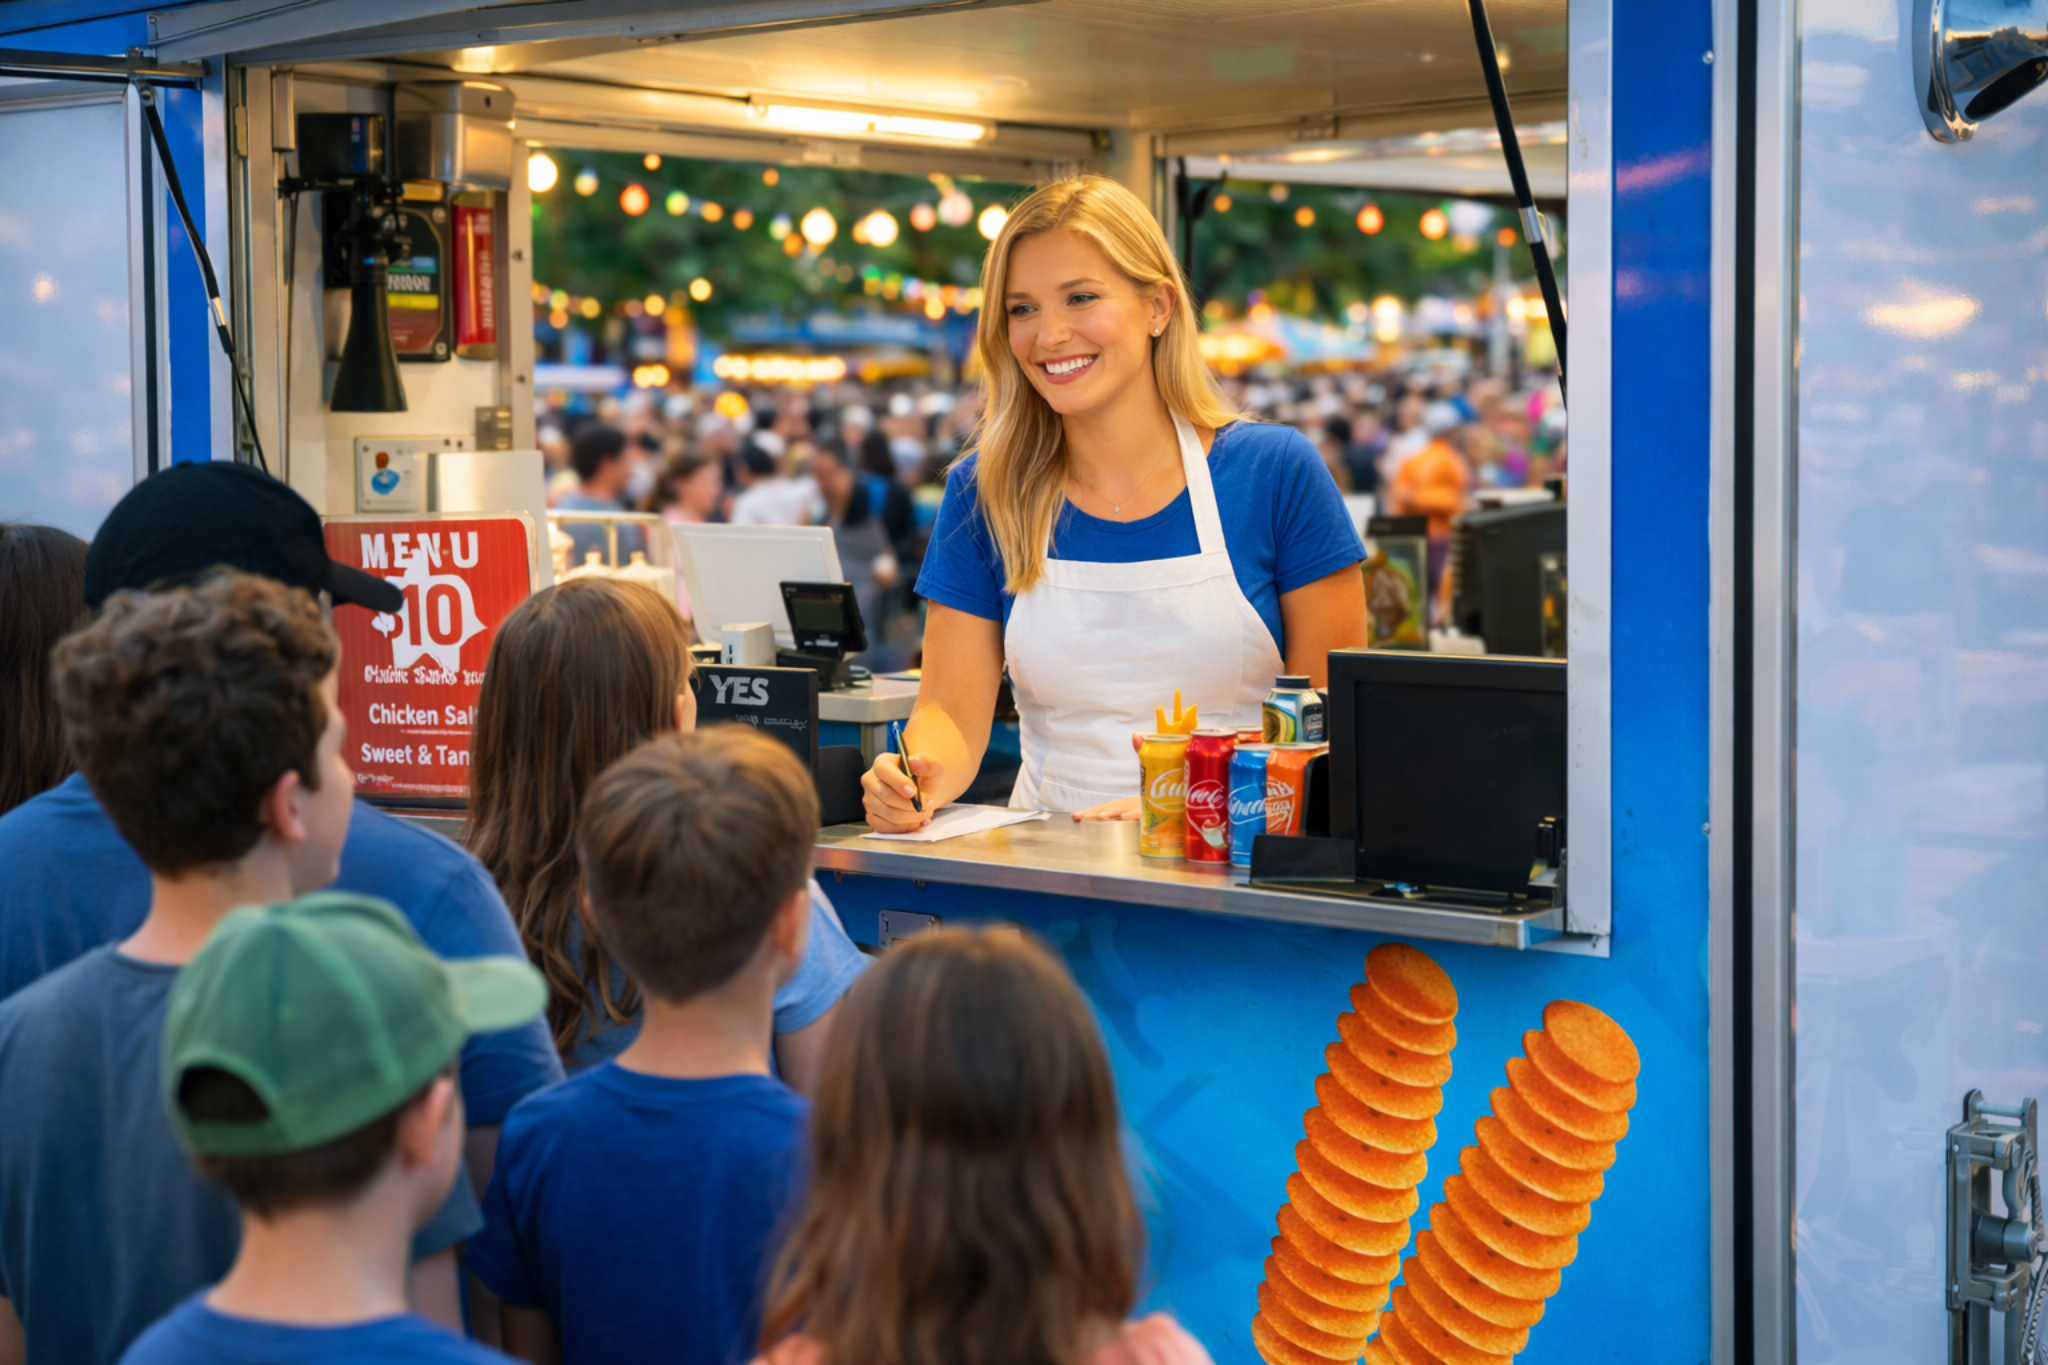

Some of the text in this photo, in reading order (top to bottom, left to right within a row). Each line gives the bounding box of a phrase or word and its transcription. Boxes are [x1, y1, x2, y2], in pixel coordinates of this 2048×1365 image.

[708, 674, 769, 706] YES
[368, 703, 439, 726] Chicken
[361, 742, 413, 765] Sweet
[417, 744, 432, 766] &
